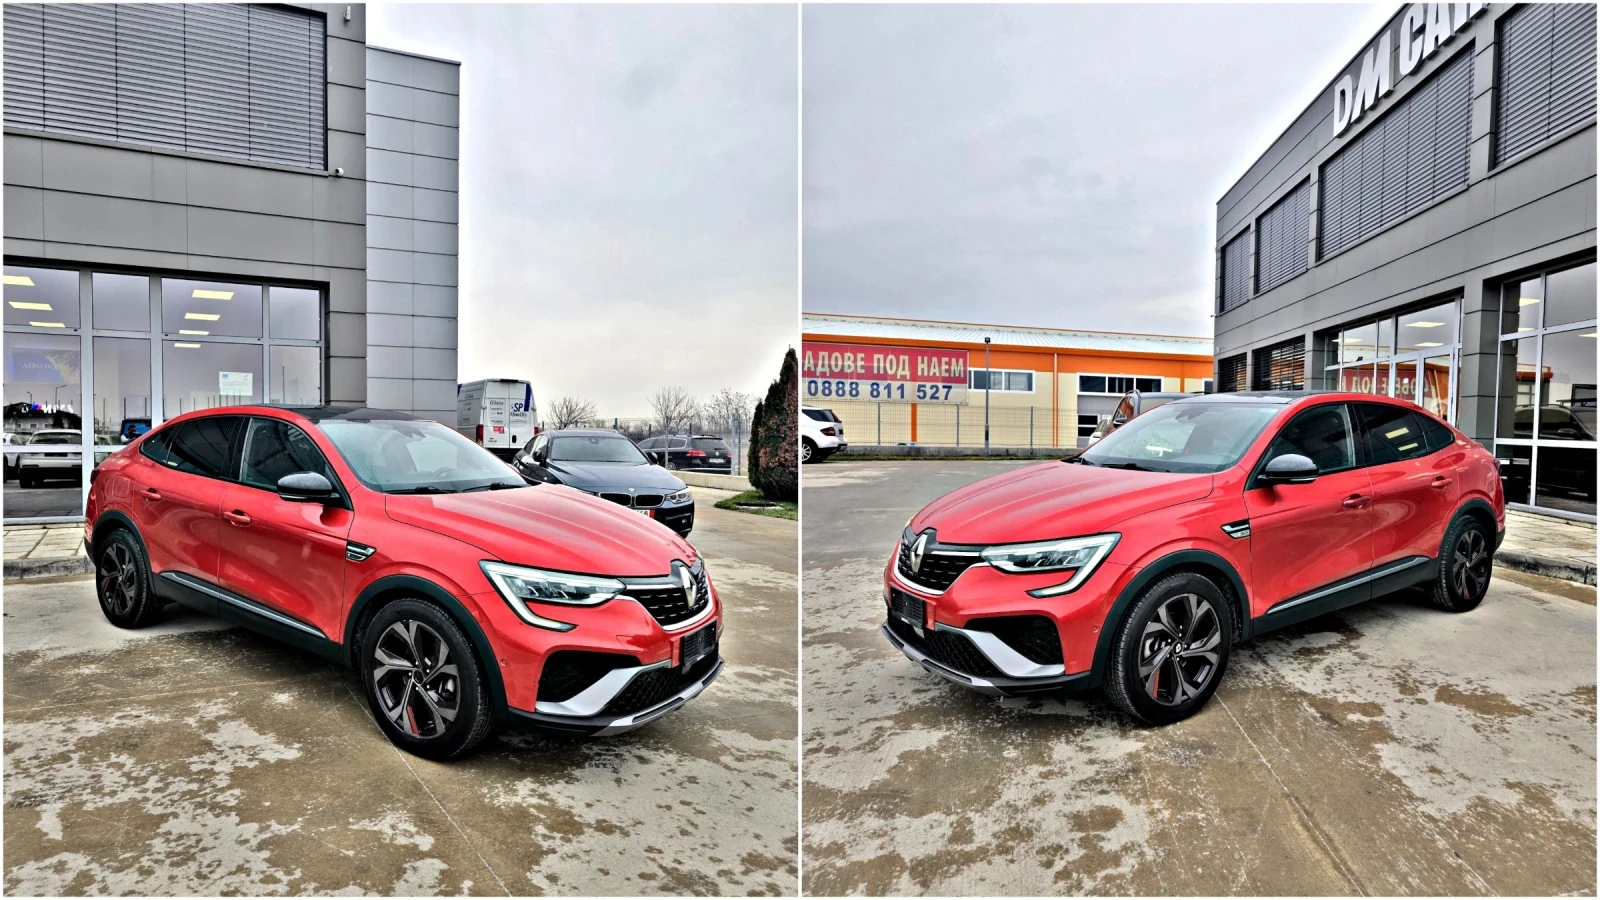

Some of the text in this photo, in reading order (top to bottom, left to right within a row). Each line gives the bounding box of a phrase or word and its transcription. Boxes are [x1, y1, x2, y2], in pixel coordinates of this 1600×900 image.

[1333, 29, 1391, 138] DM
[873, 353, 910, 380] ПОД
[917, 356, 964, 378] НАЕМ
[807, 379, 953, 401] 0888 811 527
[513, 402, 524, 412] SP
